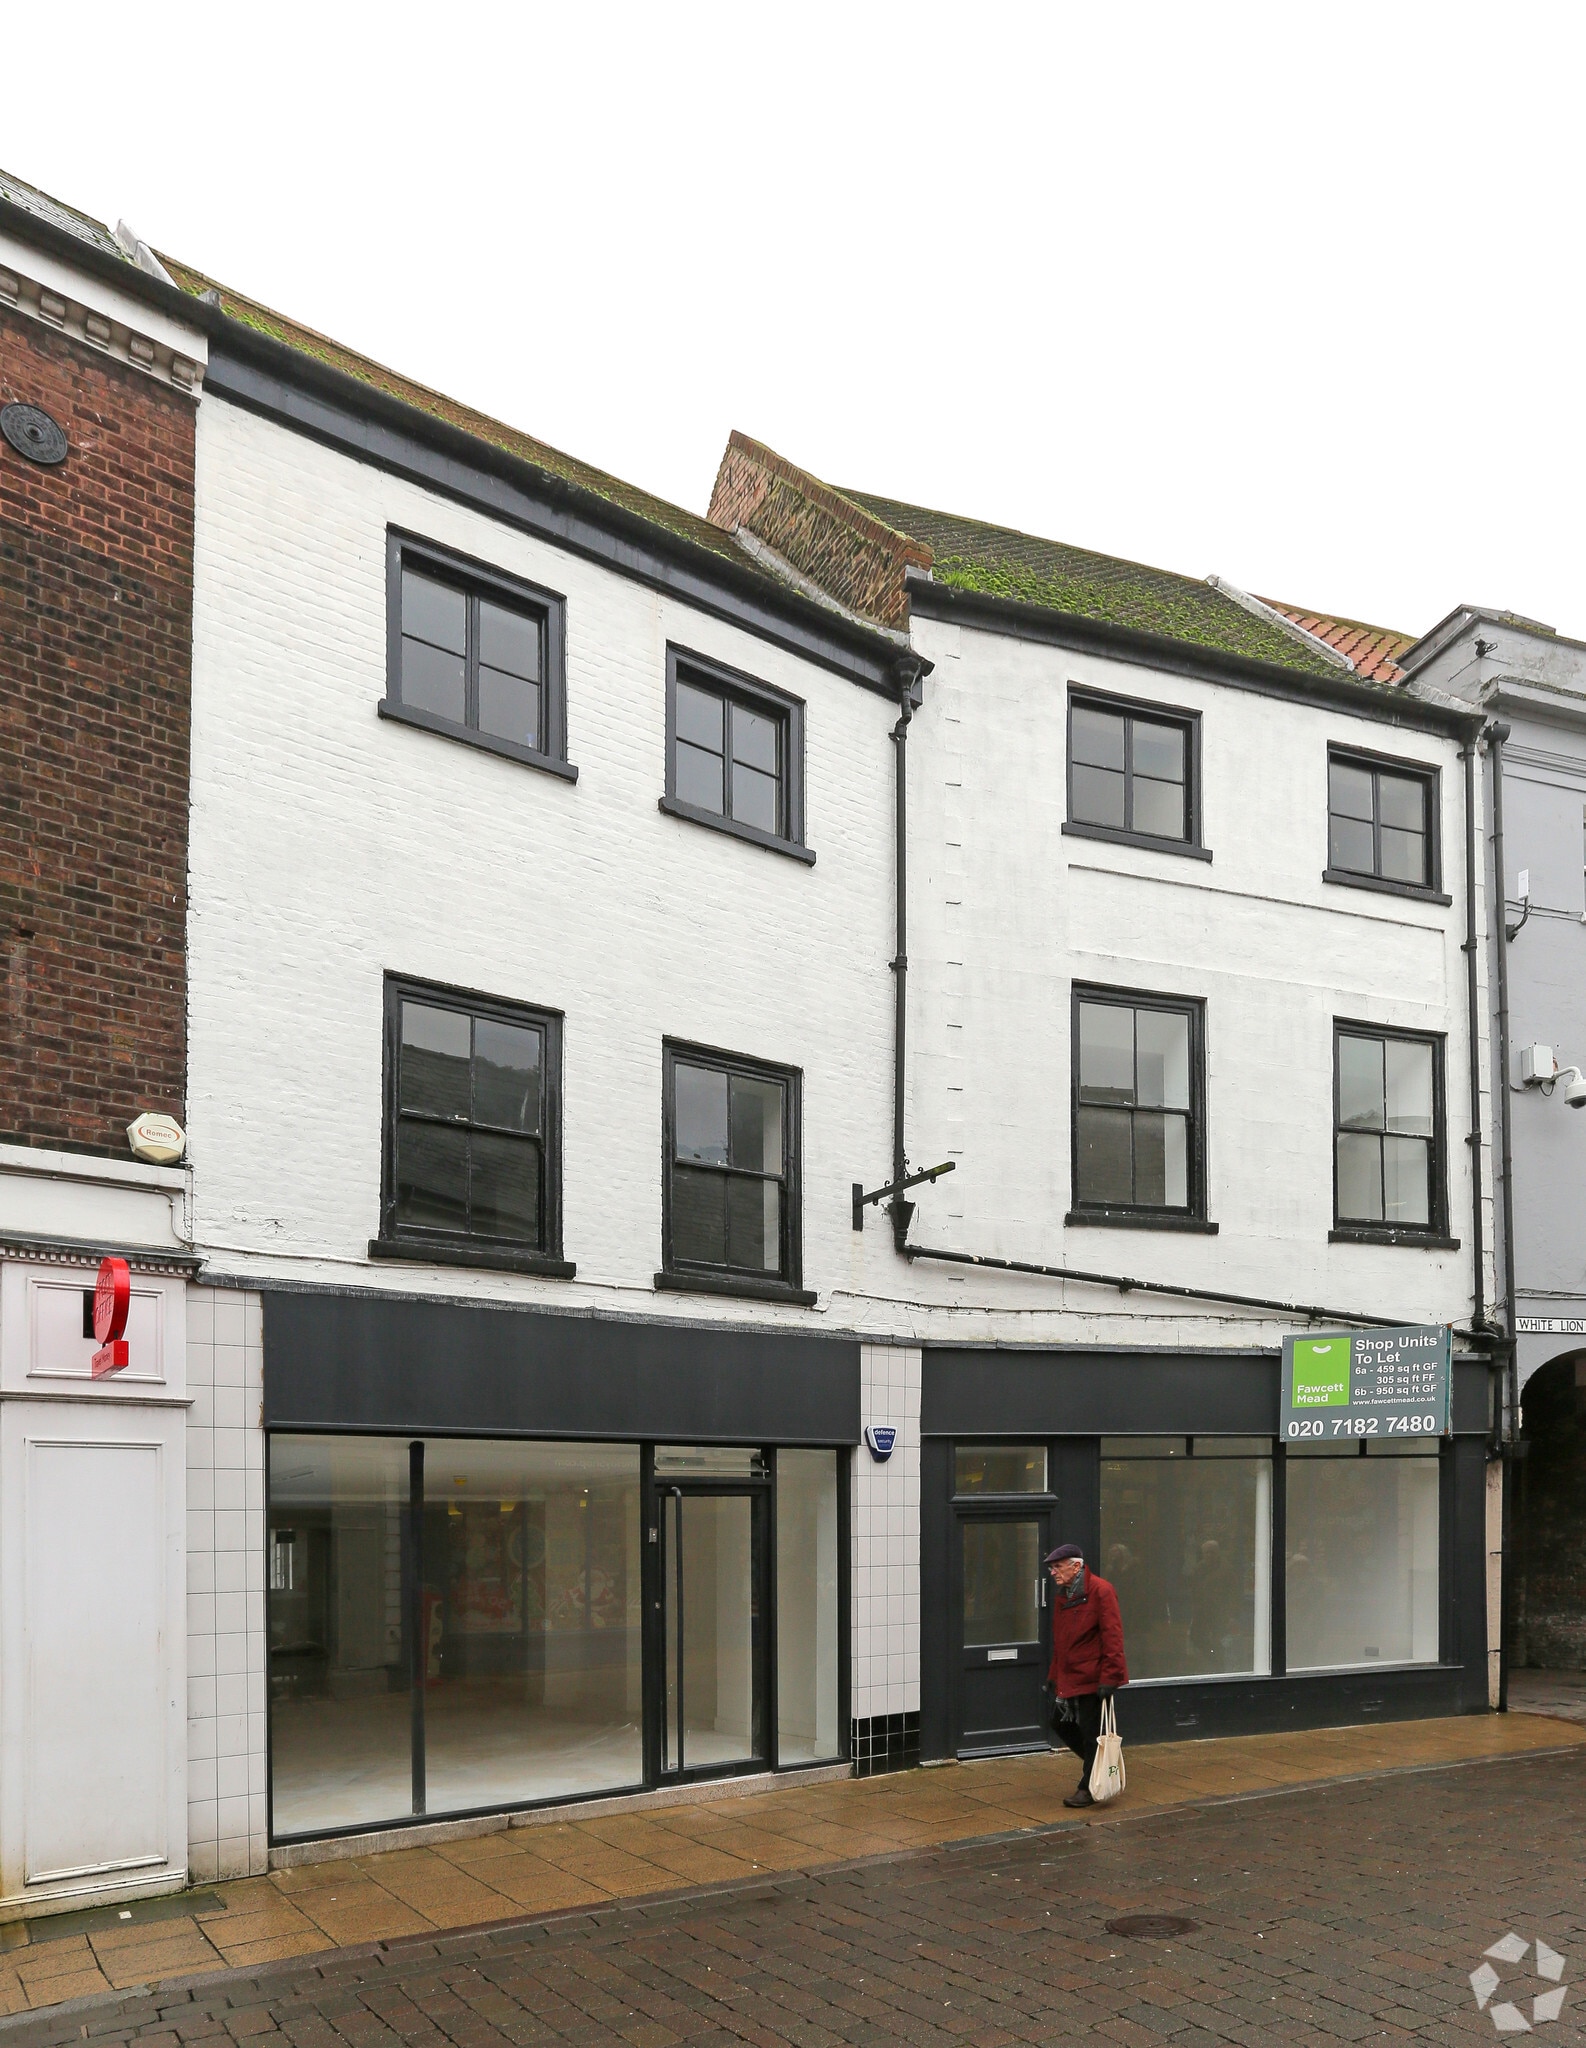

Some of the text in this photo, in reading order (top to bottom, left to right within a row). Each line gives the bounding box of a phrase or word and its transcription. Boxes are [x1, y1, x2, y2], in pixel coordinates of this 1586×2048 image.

[146, 1129, 172, 1139] Romec
[1519, 1319, 1584, 1332] WHITE LION
[1355, 1335, 1438, 1351] Shop Units
[1355, 1351, 1401, 1365] To Let
[1355, 1366, 1367, 1375] 6a
[1376, 1364, 1395, 1373] 459
[1397, 1365, 1410, 1373] sq
[1412, 1363, 1420, 1371] ft
[1422, 1362, 1438, 1371] GF
[1376, 1373, 1436, 1384] 305 sq ft FF
[1297, 1383, 1344, 1394] Fawcett
[1354, 1388, 1367, 1396] 6b
[1376, 1386, 1394, 1395] 950
[1396, 1387, 1409, 1395] sq
[1411, 1385, 1420, 1393] ft
[1422, 1384, 1437, 1392] GF
[1297, 1393, 1329, 1403] Mead
[1352, 1395, 1436, 1405] www.fawcettmead.co.uk
[1288, 1414, 1436, 1437] 020 7182 7480
